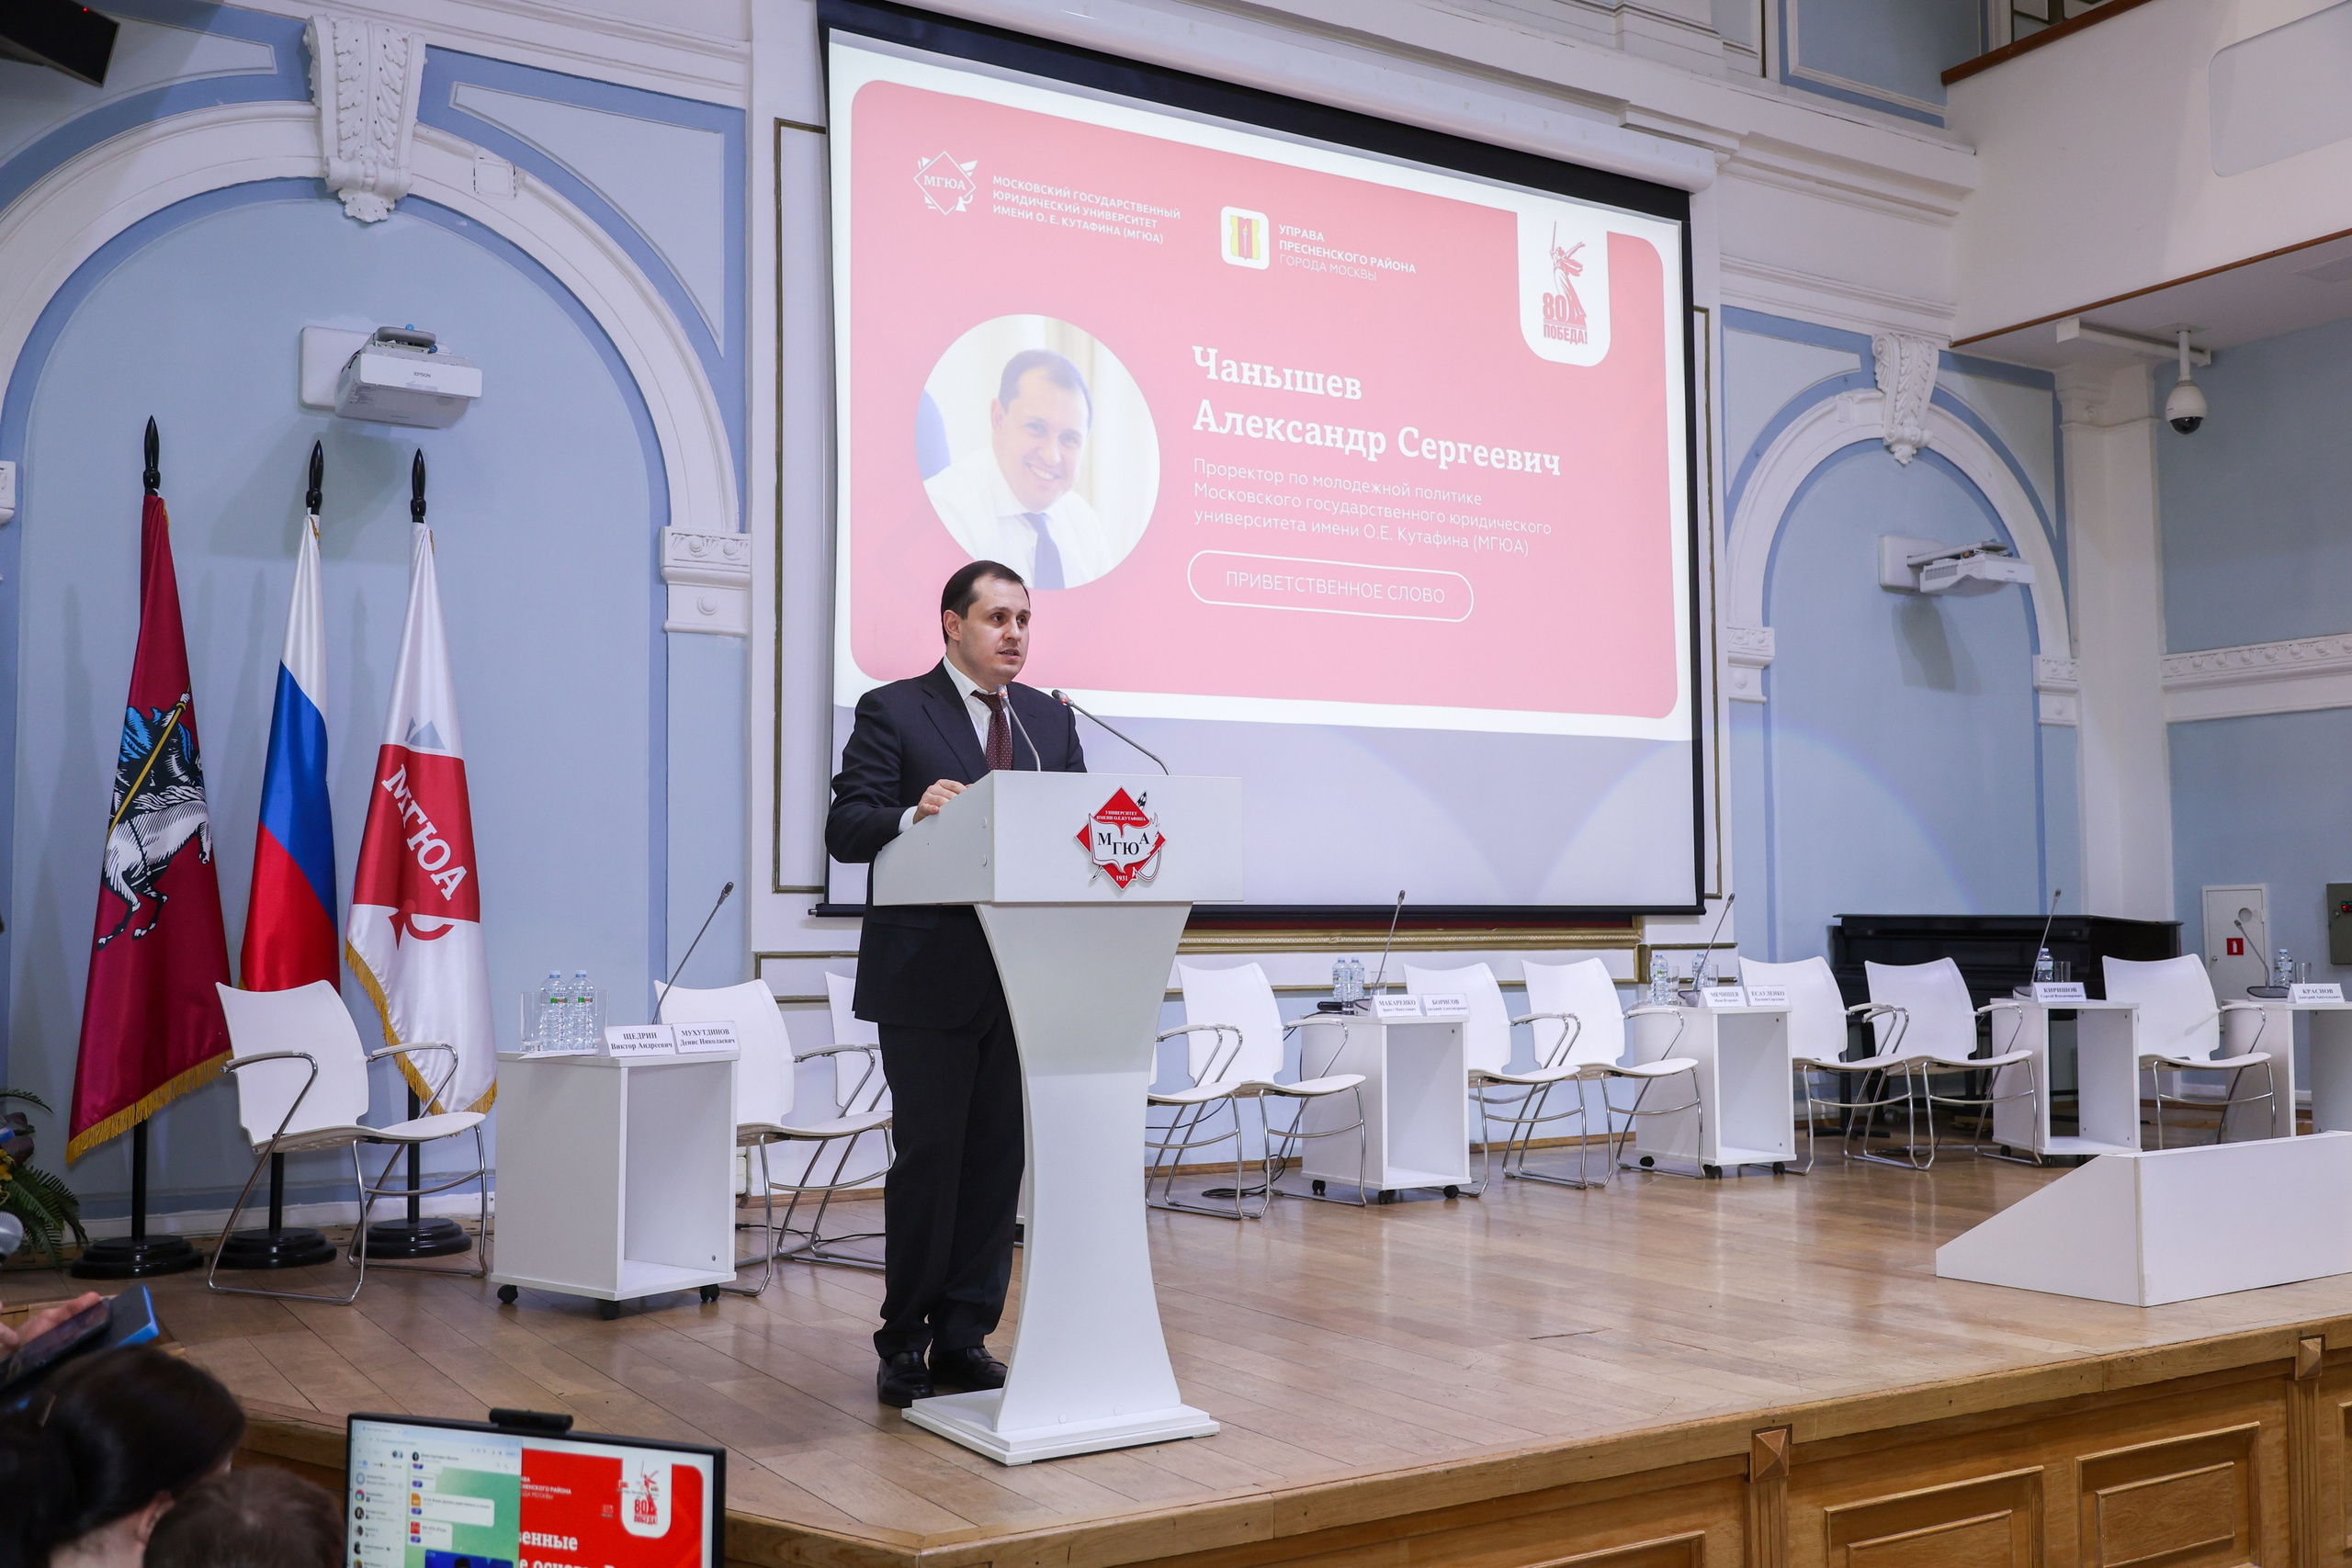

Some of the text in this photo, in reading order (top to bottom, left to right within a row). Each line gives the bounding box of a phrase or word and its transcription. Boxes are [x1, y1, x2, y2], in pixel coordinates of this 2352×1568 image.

[923, 175, 967, 190] МГЮА
[992, 175, 1182, 220] МОСКОВСКИЙ ГОСУДАРСТВЕННЫЙ
[992, 190, 1158, 229] ЮРИДИЧЕСКИЙ УНИВЕРСИТЕТ
[992, 204, 1164, 244] ИМЕНИ О. Е. КУТАФИНА (МГЮА)
[1279, 224, 1325, 243] УПРАВА
[1279, 240, 1417, 274] ПРЕСНЕНСКОГО РАЙОНА
[1279, 254, 1378, 281] ГОРОДА МОСКВЫ
[1543, 292, 1567, 322] 80
[1544, 323, 1588, 345] ПОБЕДА!
[1193, 345, 1363, 400] Чанышев
[1193, 399, 1561, 476] Александр Сергеевич
[1193, 457, 1483, 506] Проректор по молодежной политике
[1194, 482, 1552, 537] Московского государственного юридического
[1194, 508, 1530, 558] университета имени О.Е. Кутафина (МГЮА)
[1226, 570, 1445, 604] ПРИВЕТСТВЕННОЕ СЛОВО
[381, 763, 468, 901] МГЮА
[1098, 832, 1149, 855] МГЮА
[611, 1042, 673, 1051] Виктор Андреевич
[623, 1032, 658, 1041] ЩЕДРИН
[681, 1028, 730, 1037] МУХУТДИНОВ
[699, 1037, 736, 1045] Николаевич
[635, 1499, 647, 1514] 80
